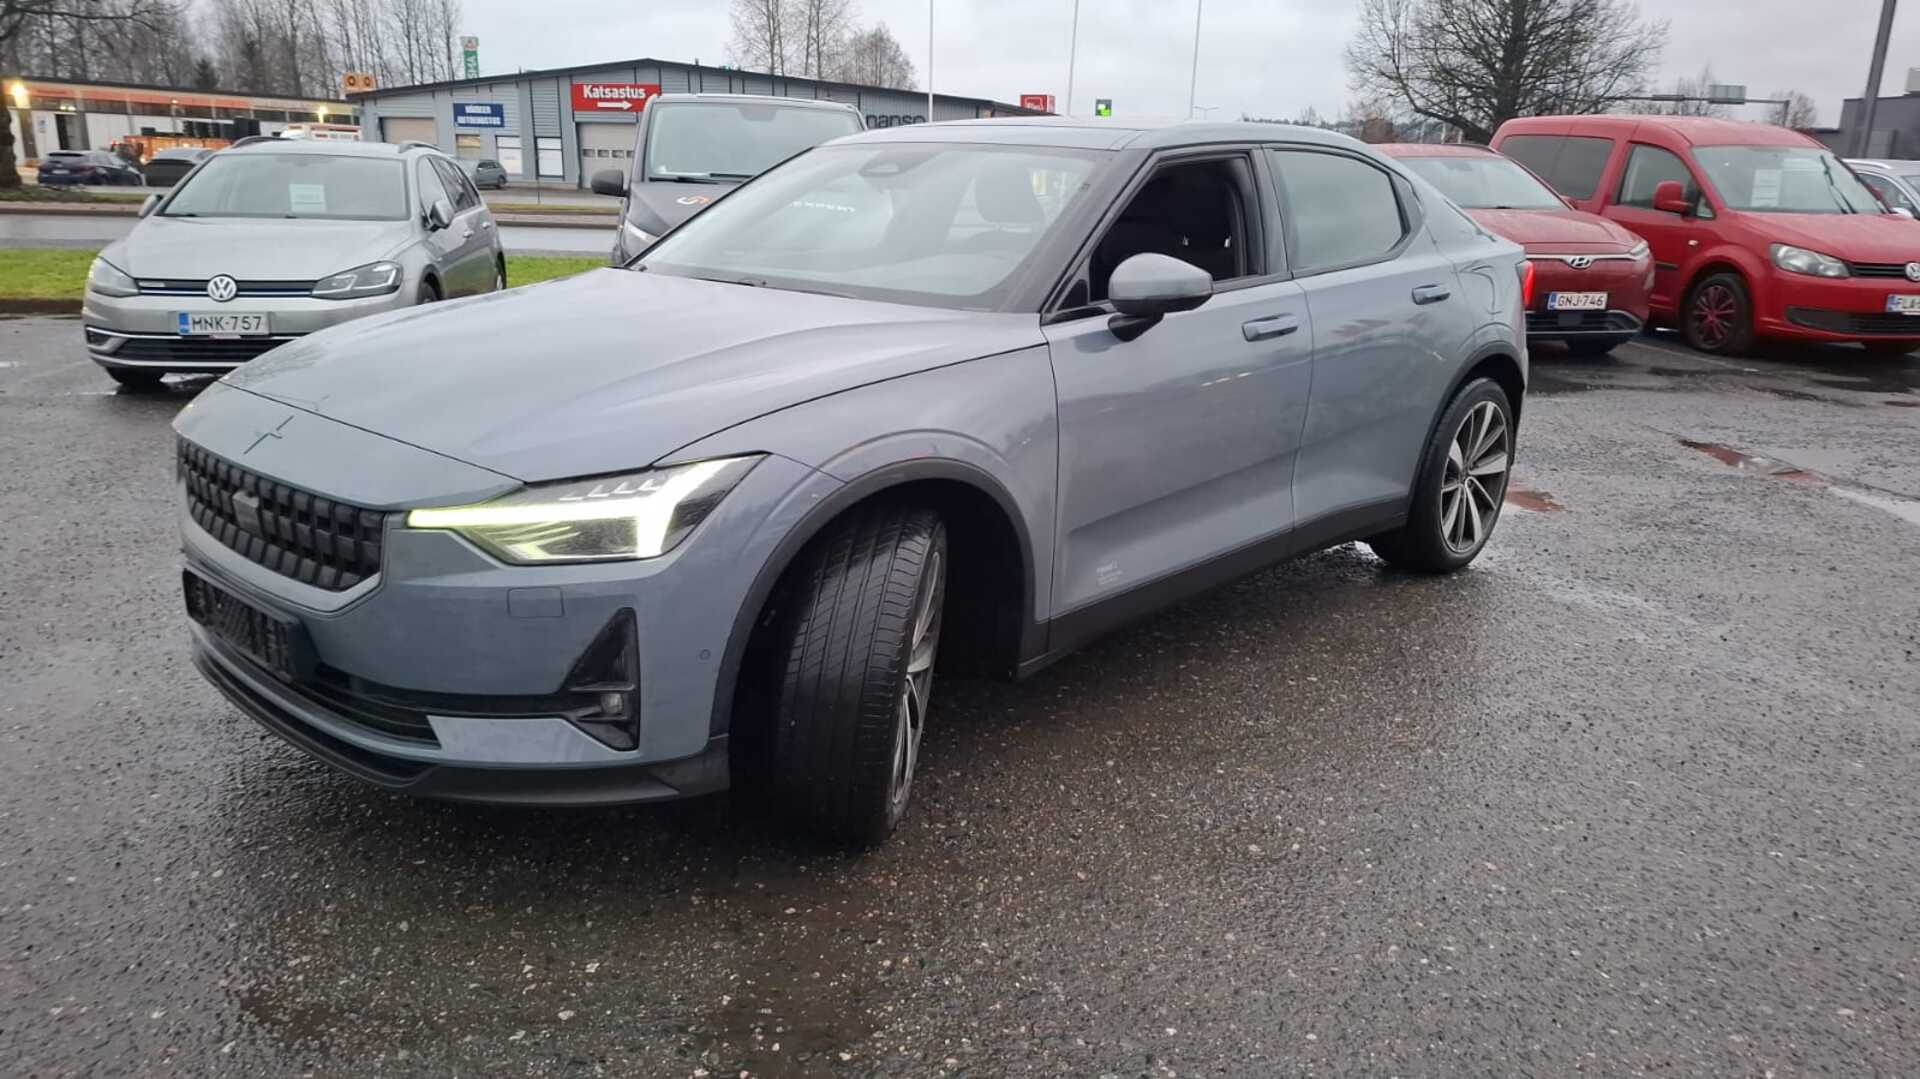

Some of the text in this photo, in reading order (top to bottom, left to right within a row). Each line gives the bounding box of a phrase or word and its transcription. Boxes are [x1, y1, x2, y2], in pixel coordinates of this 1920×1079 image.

[583, 84, 647, 100] Katsastus
[1558, 295, 1604, 307] GNJ-746
[192, 315, 262, 331] MNK-757
